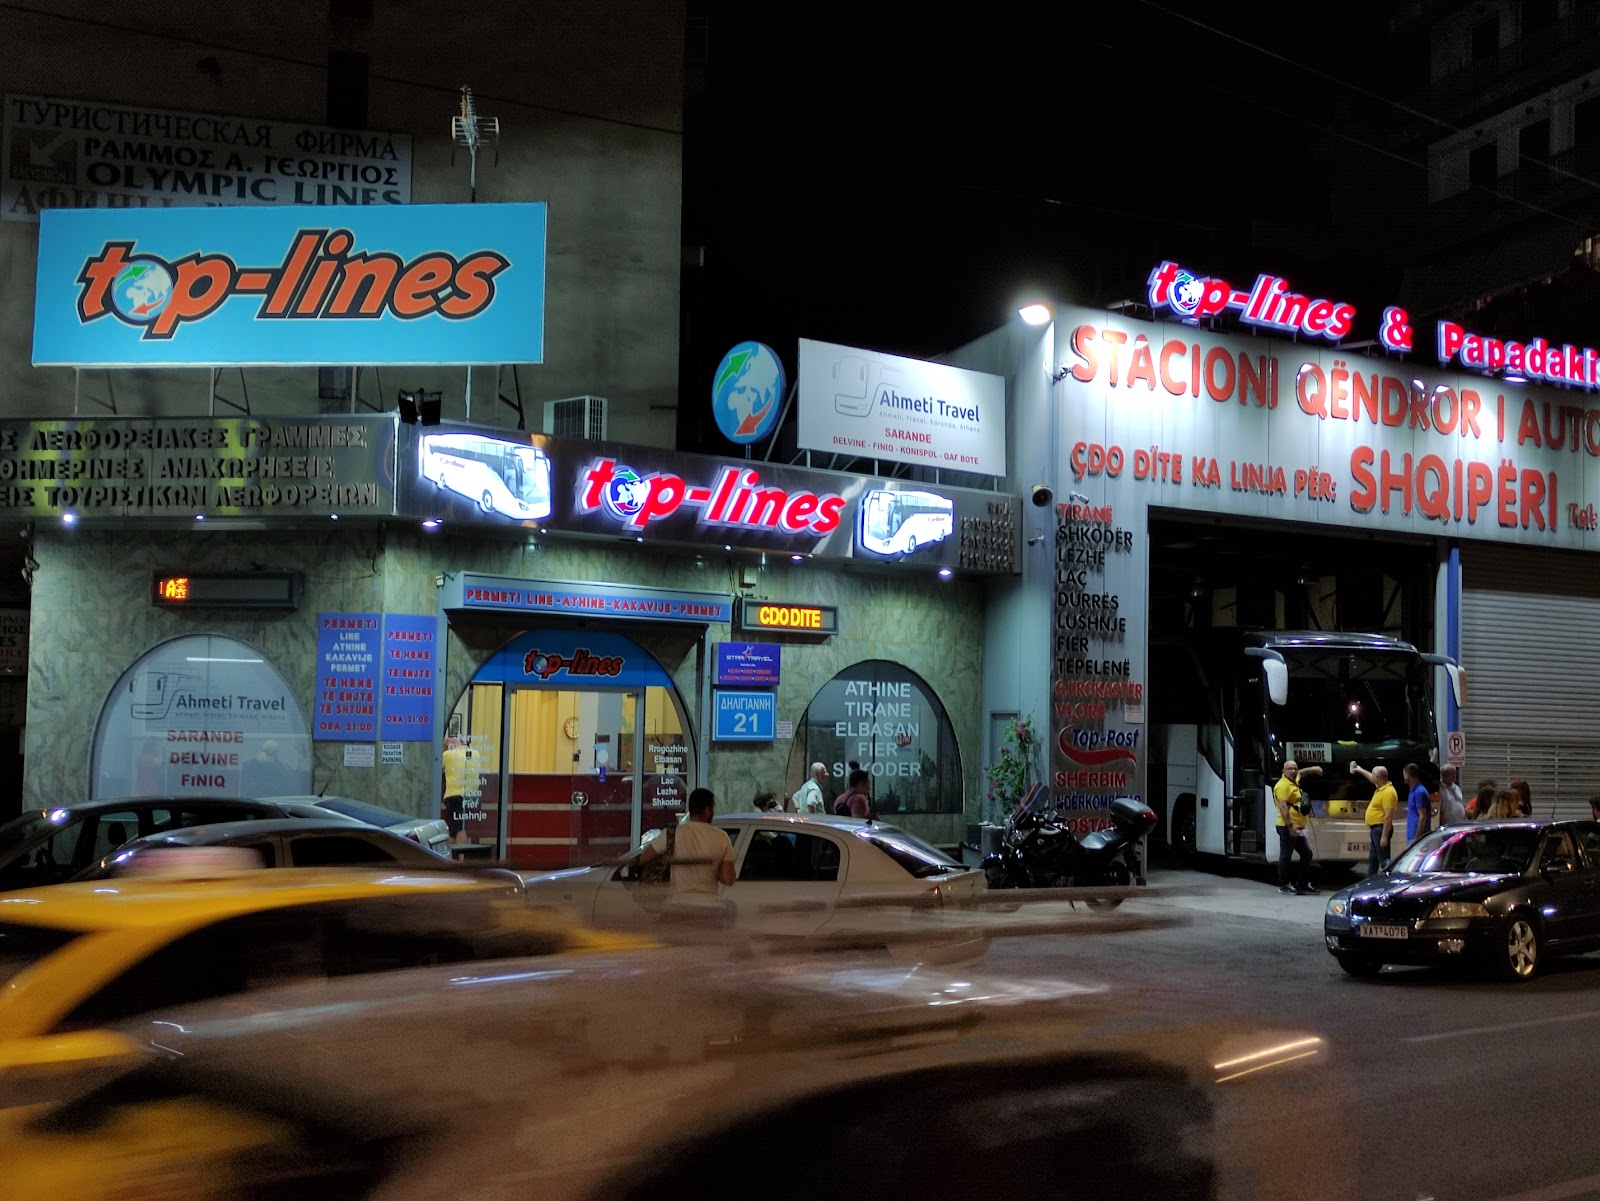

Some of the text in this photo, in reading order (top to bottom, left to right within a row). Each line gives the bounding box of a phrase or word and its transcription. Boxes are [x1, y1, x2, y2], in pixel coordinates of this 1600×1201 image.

[12, 99, 399, 160] ТУРИСТИЧЕСКАЯ ФИРМА
[86, 162, 277, 202] OLYMPIC
[295, 181, 402, 205] LINES
[76, 228, 511, 341] top-lines
[1148, 260, 1600, 388] top-lines & Papadaki
[1070, 325, 1279, 410] STACIONI
[1296, 360, 1481, 439] QËNDROR
[1496, 393, 1505, 443] I
[880, 390, 980, 422] Ahmeti Travel
[32, 428, 229, 451] ΛΕΩΦΟΡΕΙΑΚΕΣ
[240, 425, 368, 448] ΓΡΑΜΜΕΣ
[885, 427, 932, 444] SARANDE
[833, 436, 866, 448] DELVINE
[873, 442, 894, 452] FINIQ
[900, 446, 938, 459] KONISPOL
[944, 452, 959, 461] QAF
[960, 455, 979, 465] BOTE
[161, 456, 336, 479] ΑΝΑΧΩΡΗΣΕΙΣ
[45, 485, 207, 508] ΤΟΥΡΙΣΤΙΚΩΝ
[216, 482, 379, 508] ΛΕΩΦΟΡΕΙΩΝ
[1071, 441, 1124, 481] ÇDO
[1192, 456, 1221, 487] KA
[1231, 461, 1287, 496] LINJA
[1295, 465, 1337, 502] PËR:
[1350, 445, 1558, 532] SHQIPËRI
[575, 456, 848, 537] top-lines
[1056, 503, 1113, 524] TIRANË
[1056, 525, 1133, 547] SHKODËR
[1057, 547, 1105, 566] LEZHË
[1057, 569, 1087, 589] LAÇ
[466, 589, 522, 604] PERMETI
[1056, 591, 1119, 610] DURRËS
[323, 618, 378, 630] PERMETI
[759, 606, 821, 629] CDO DITE
[1056, 613, 1126, 633] LUSHNJE
[340, 632, 360, 641] LINE
[388, 631, 433, 642] PERMETI
[1057, 636, 1089, 652] FIER
[332, 642, 367, 652] ATHINE
[390, 650, 401, 659] TE
[325, 653, 373, 663] KAKAVIJE
[523, 648, 626, 680] top-lines
[330, 664, 367, 673] PERMET
[388, 668, 430, 679] TE ENJTE
[1057, 658, 1130, 676] TEPELENË
[324, 678, 336, 688] TE
[385, 686, 432, 696] TE SHTUNE
[845, 680, 911, 698] ATHINE
[1055, 679, 1142, 699] GJIROKASTËR
[176, 694, 286, 711] Ahmeti Travel
[322, 692, 373, 702] TE ENJTE
[720, 697, 771, 711] ΔΗΛΙΓΙΑΝΝΗ
[320, 704, 374, 715] TE SHTUNE
[844, 701, 911, 718] TIRANE
[1055, 700, 1107, 720] VLORË
[319, 722, 373, 732] ORA 21:00
[407, 715, 429, 724] 21:00
[733, 712, 758, 733] 21
[167, 730, 244, 743] SARANDE
[835, 721, 919, 737] ELBASAN
[1072, 728, 1139, 749] Top-Post
[648, 744, 689, 754] Rrogozhine
[857, 742, 898, 757] FIER
[170, 752, 239, 766] DELVINE
[654, 755, 683, 763] Elbasan
[661, 776, 674, 785] Lac
[1055, 769, 1128, 788] SHËRBIM
[657, 787, 678, 795] Lezhe
[462, 799, 480, 808] Fier
[652, 798, 682, 806] Shkoder
[453, 811, 487, 821] Lushnje
